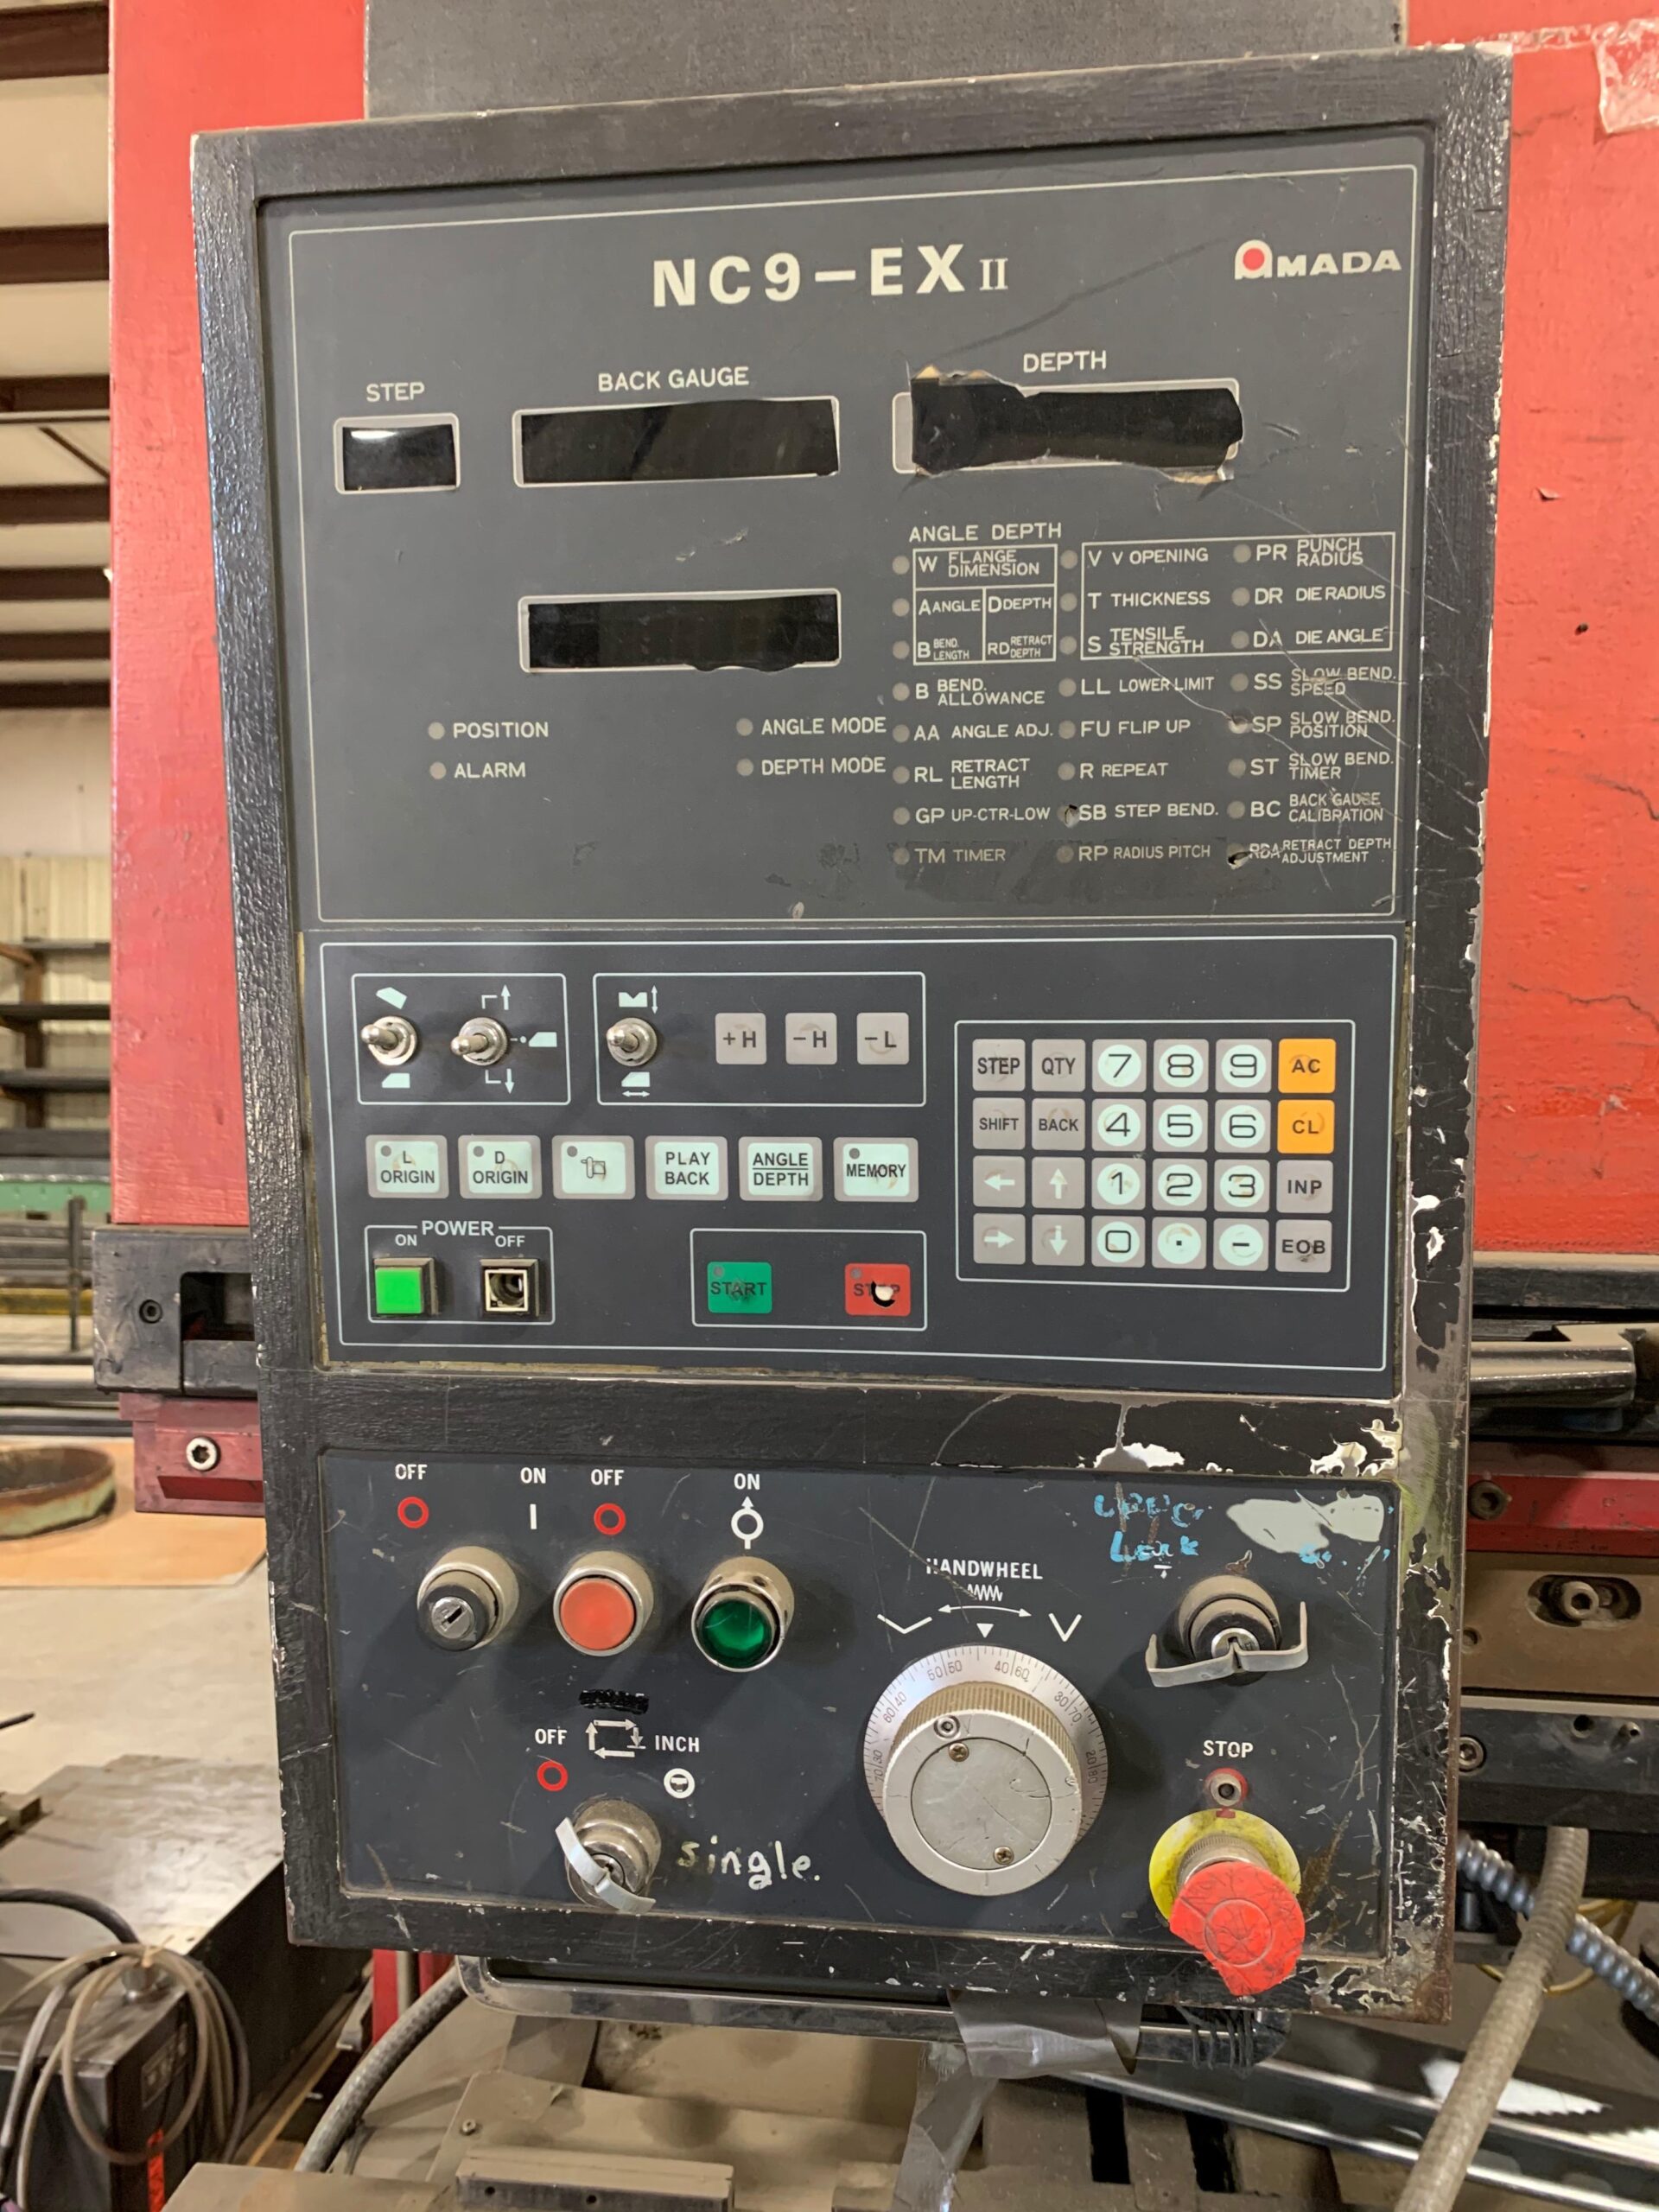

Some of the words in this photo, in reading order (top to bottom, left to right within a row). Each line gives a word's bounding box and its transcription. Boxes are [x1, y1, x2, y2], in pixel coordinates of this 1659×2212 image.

[1235, 240, 1402, 280] AMADA
[1023, 351, 1107, 372] DEPTH
[598, 372, 661, 392] BACK
[668, 367, 749, 389] GAUGE
[366, 383, 425, 402] STEP
[909, 525, 978, 543] ANGLE
[992, 522, 1061, 541] DEPTH
[1256, 544, 1287, 561] PR
[1297, 537, 1360, 552] PUNCH
[918, 556, 938, 573] W
[949, 550, 1017, 564] FLANGE
[1088, 550, 1102, 567] V
[1129, 548, 1208, 564] OPENING
[1296, 551, 1363, 567] RADIUS
[949, 563, 1039, 577] DIMENSION
[1003, 596, 1052, 610] DEPTH
[1088, 593, 1102, 609] T
[1111, 591, 1211, 607] THICKNESS
[1255, 588, 1284, 605] DR
[1296, 587, 1322, 601] DIE
[1325, 585, 1386, 601] RADIUS
[932, 600, 981, 613] ANGLE
[1010, 634, 1052, 646] RETRACT
[1109, 626, 1185, 642] TENSILE
[1254, 631, 1283, 648] DA
[1296, 630, 1322, 645] DIE
[1327, 628, 1382, 643] ANGLE
[917, 642, 931, 658] B
[988, 642, 1009, 655] RD
[1088, 636, 1102, 653] S
[1109, 639, 1204, 656] STRENGTH
[933, 650, 969, 660] LENGTH
[1010, 648, 1040, 658] DEPTH
[1081, 678, 1111, 695] LL
[1120, 678, 1170, 692] LOWER
[1175, 677, 1214, 691] LIMIT
[1254, 672, 1282, 690] SS
[916, 683, 929, 699] B
[1291, 683, 1346, 696] SPEED
[938, 691, 1046, 706] ALLOWANCE
[761, 718, 825, 735] ANGLE
[831, 716, 887, 734] MODE
[1252, 716, 1282, 733] SP
[1290, 712, 1339, 725] SLOW
[453, 721, 549, 739] POSITION
[914, 725, 940, 741] AA
[951, 724, 1009, 740] ANGLE
[1081, 721, 1110, 737] FU
[1118, 721, 1160, 734] FLIP
[1166, 720, 1191, 733] UP
[1290, 724, 1368, 738] POSITION
[761, 758, 824, 776] DEPTH
[831, 756, 887, 774] MODE
[951, 758, 1030, 773] RETRACT
[1250, 759, 1279, 776] ST
[1289, 753, 1339, 766] SLOW
[454, 762, 526, 779] ALARM
[914, 766, 943, 783] RL
[1080, 763, 1094, 779] R
[1102, 763, 1168, 777] REPEAT
[1289, 766, 1341, 779] TIMER
[951, 776, 1020, 790] LENGTH
[1289, 793, 1327, 807] BACK
[1332, 792, 1381, 806] GAUGE
[916, 807, 945, 823] GP
[1080, 804, 1107, 821] SB
[1115, 804, 1161, 818] STEP
[1250, 801, 1281, 817] BC
[1289, 808, 1383, 822] CALIBRATION
[1282, 839, 1341, 851] RETRACT
[1348, 838, 1391, 849] DEPTH
[914, 849, 945, 863] TM
[953, 849, 1006, 861] TIMER
[1079, 845, 1108, 861] RP
[1114, 846, 1164, 860] RADIUS
[1169, 845, 1211, 858] PITCH
[1282, 851, 1369, 864] ADJUSTMENT
[977, 1057, 1020, 1075] STEP
[1041, 1057, 1076, 1076] QTY
[1108, 1053, 1132, 1078] 7
[1167, 1053, 1195, 1078] 8
[1230, 1053, 1258, 1078] 9
[1291, 1058, 1321, 1074] AC
[979, 1117, 1019, 1130] SHIFT
[1039, 1118, 1078, 1132] BACK
[1105, 1112, 1131, 1137] 4
[1166, 1113, 1194, 1138] 5
[1229, 1114, 1256, 1139] 6
[1292, 1120, 1319, 1135] CL
[403, 1151, 411, 1163] L
[495, 1151, 505, 1163] D
[665, 1151, 710, 1166] PLAY
[753, 1152, 809, 1166] ANGLE
[380, 1169, 435, 1185] ORIGIN
[473, 1170, 528, 1185] ORIGIN
[665, 1172, 709, 1185] BACK
[847, 1164, 906, 1178] MEMORY
[753, 1173, 809, 1186] DEPTH
[1110, 1171, 1123, 1195] 1
[1166, 1173, 1193, 1197] 2
[1228, 1173, 1255, 1198] 3
[1287, 1179, 1322, 1195] INP
[422, 1220, 493, 1236] POWER
[395, 1234, 417, 1246] ON
[495, 1235, 525, 1248] OFF
[1105, 1230, 1132, 1254] 0
[1281, 1239, 1326, 1255] EOB
[711, 1281, 766, 1296] START
[854, 1284, 900, 1298] STP
[394, 1464, 428, 1481] OFF
[520, 1467, 547, 1484] ON
[590, 1469, 624, 1486] OFF
[734, 1472, 760, 1491] ON
[534, 1729, 567, 1746] OFF
[655, 1735, 700, 1752] INCH
[1203, 1740, 1253, 1758] STOP
